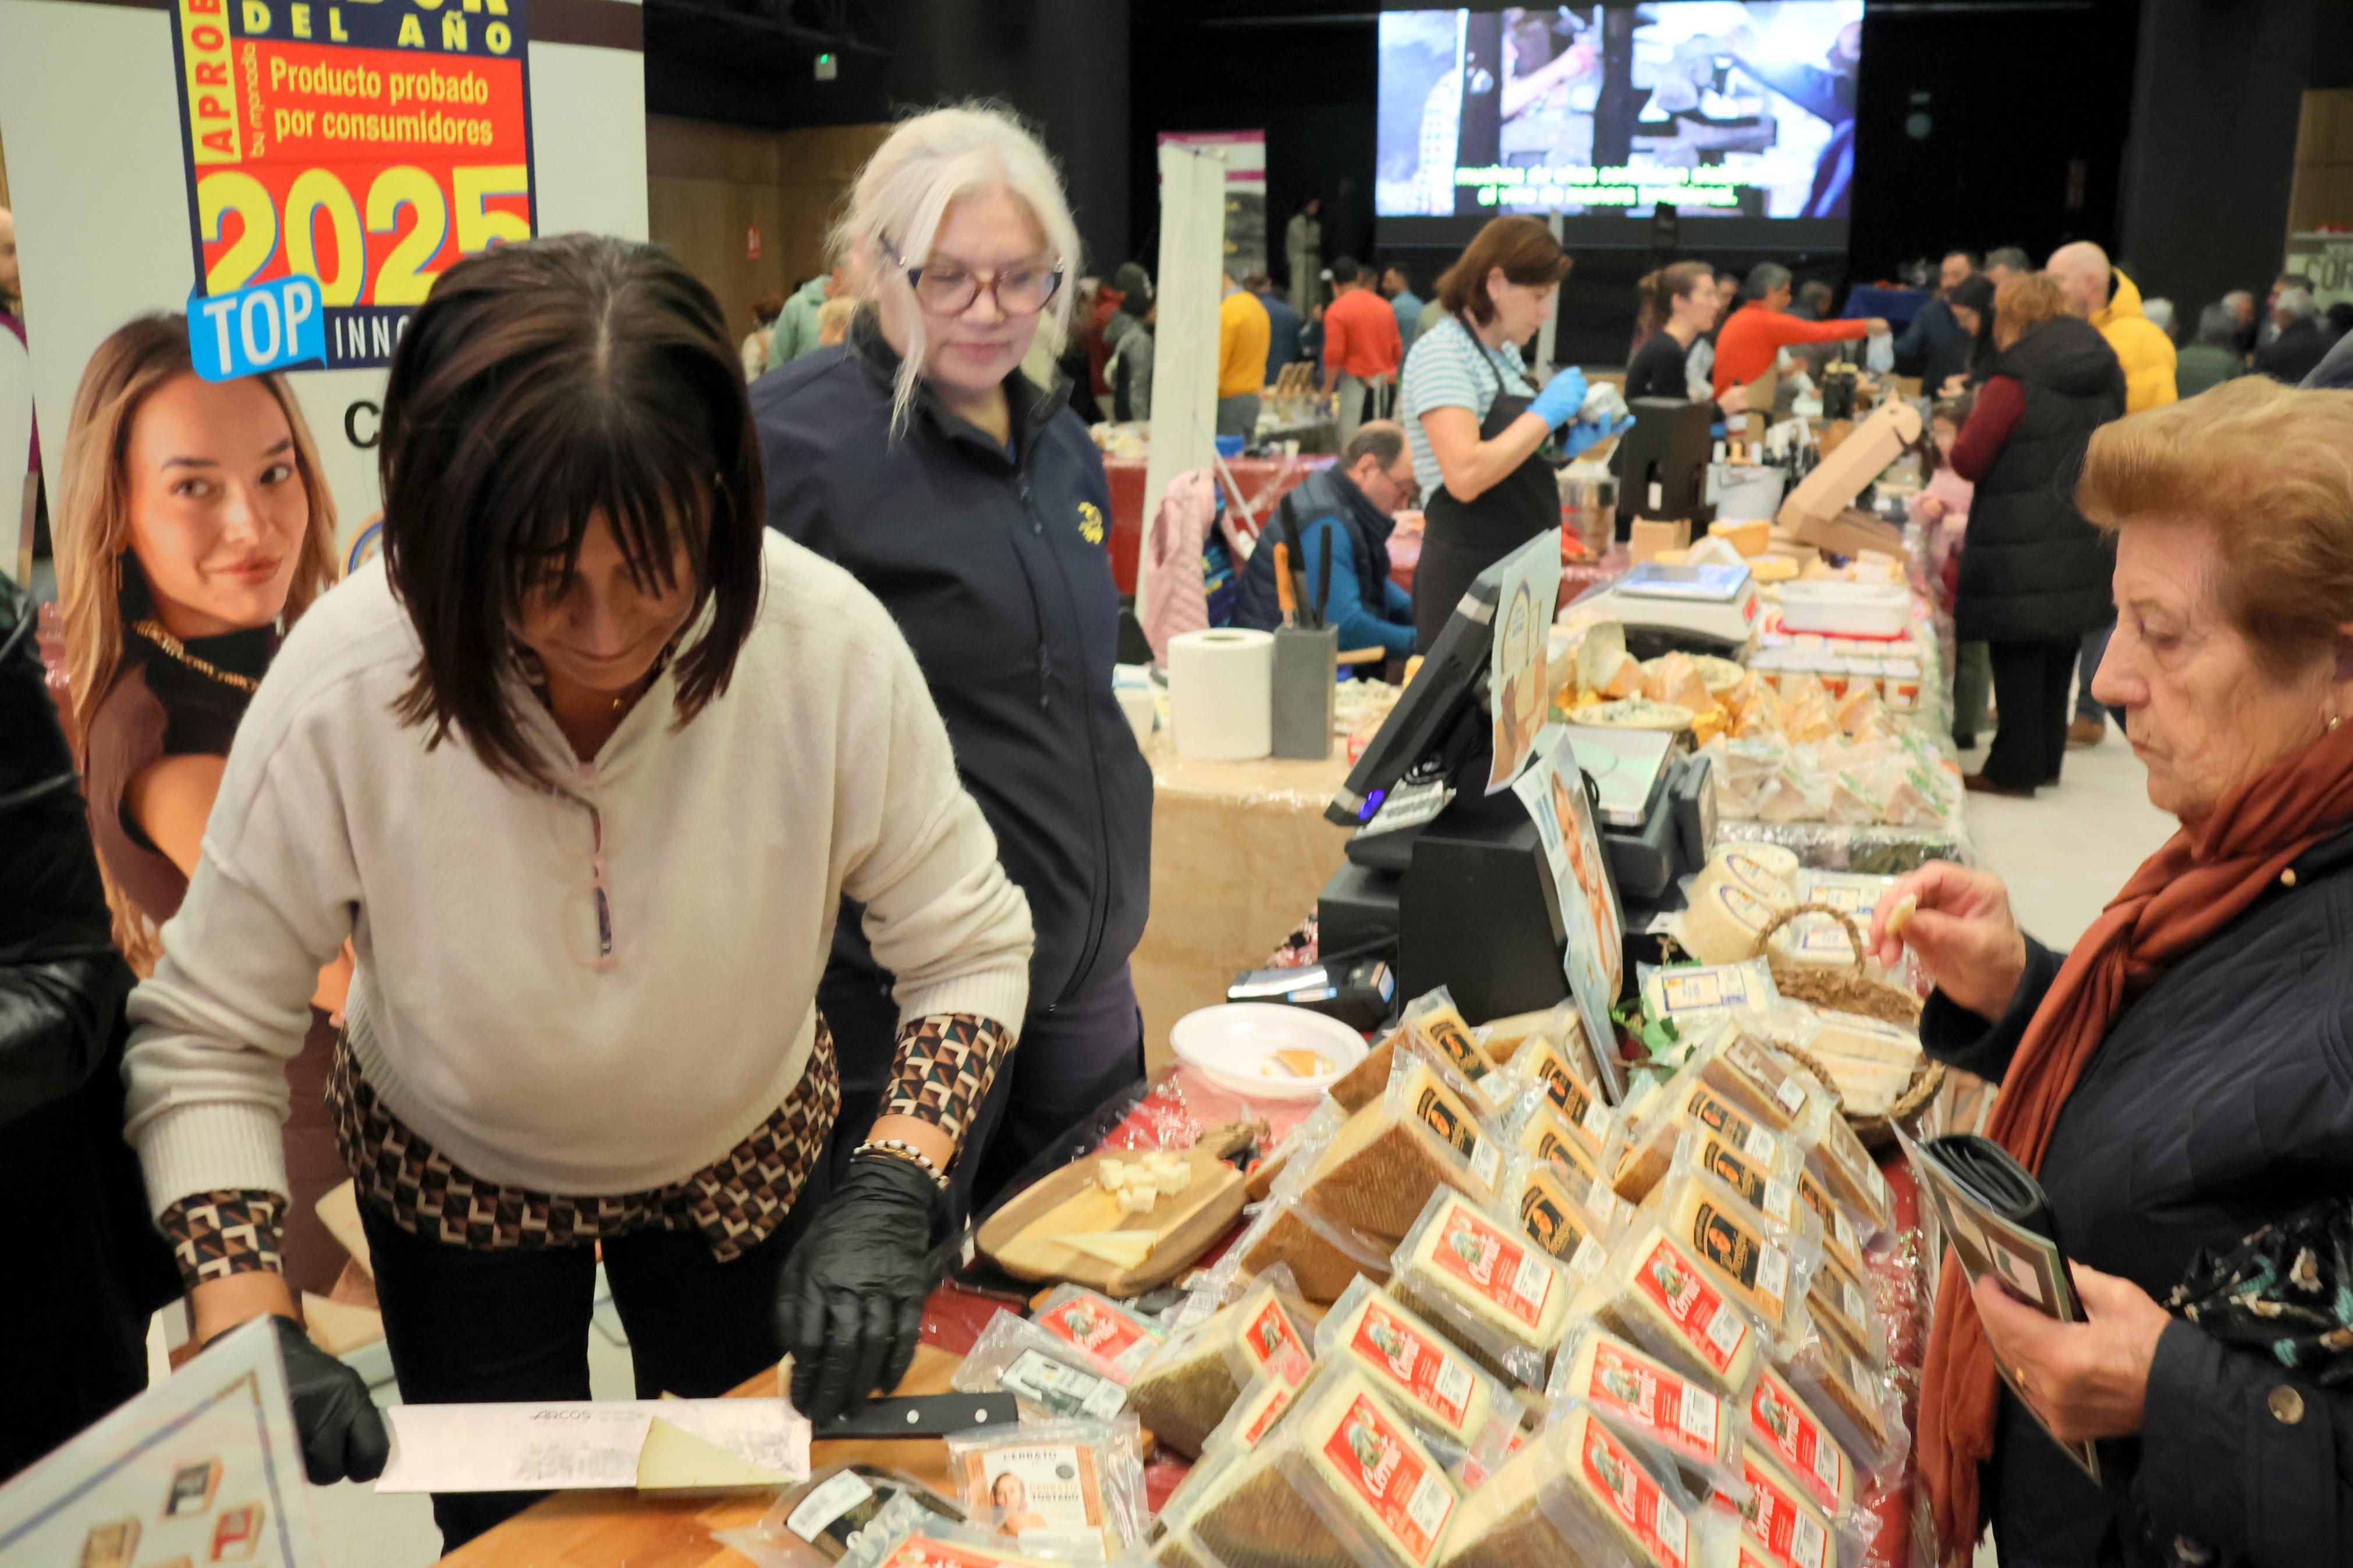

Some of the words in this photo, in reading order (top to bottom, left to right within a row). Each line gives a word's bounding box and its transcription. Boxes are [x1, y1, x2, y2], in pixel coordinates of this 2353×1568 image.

[242, 1, 348, 42] DEL
[398, 10, 511, 55] AÑO
[270, 56, 381, 99] Producto
[390, 68, 488, 106] probado
[275, 108, 315, 143] por
[323, 109, 493, 145] consumidores
[197, 166, 531, 306] 2025
[203, 282, 313, 375] TOP
